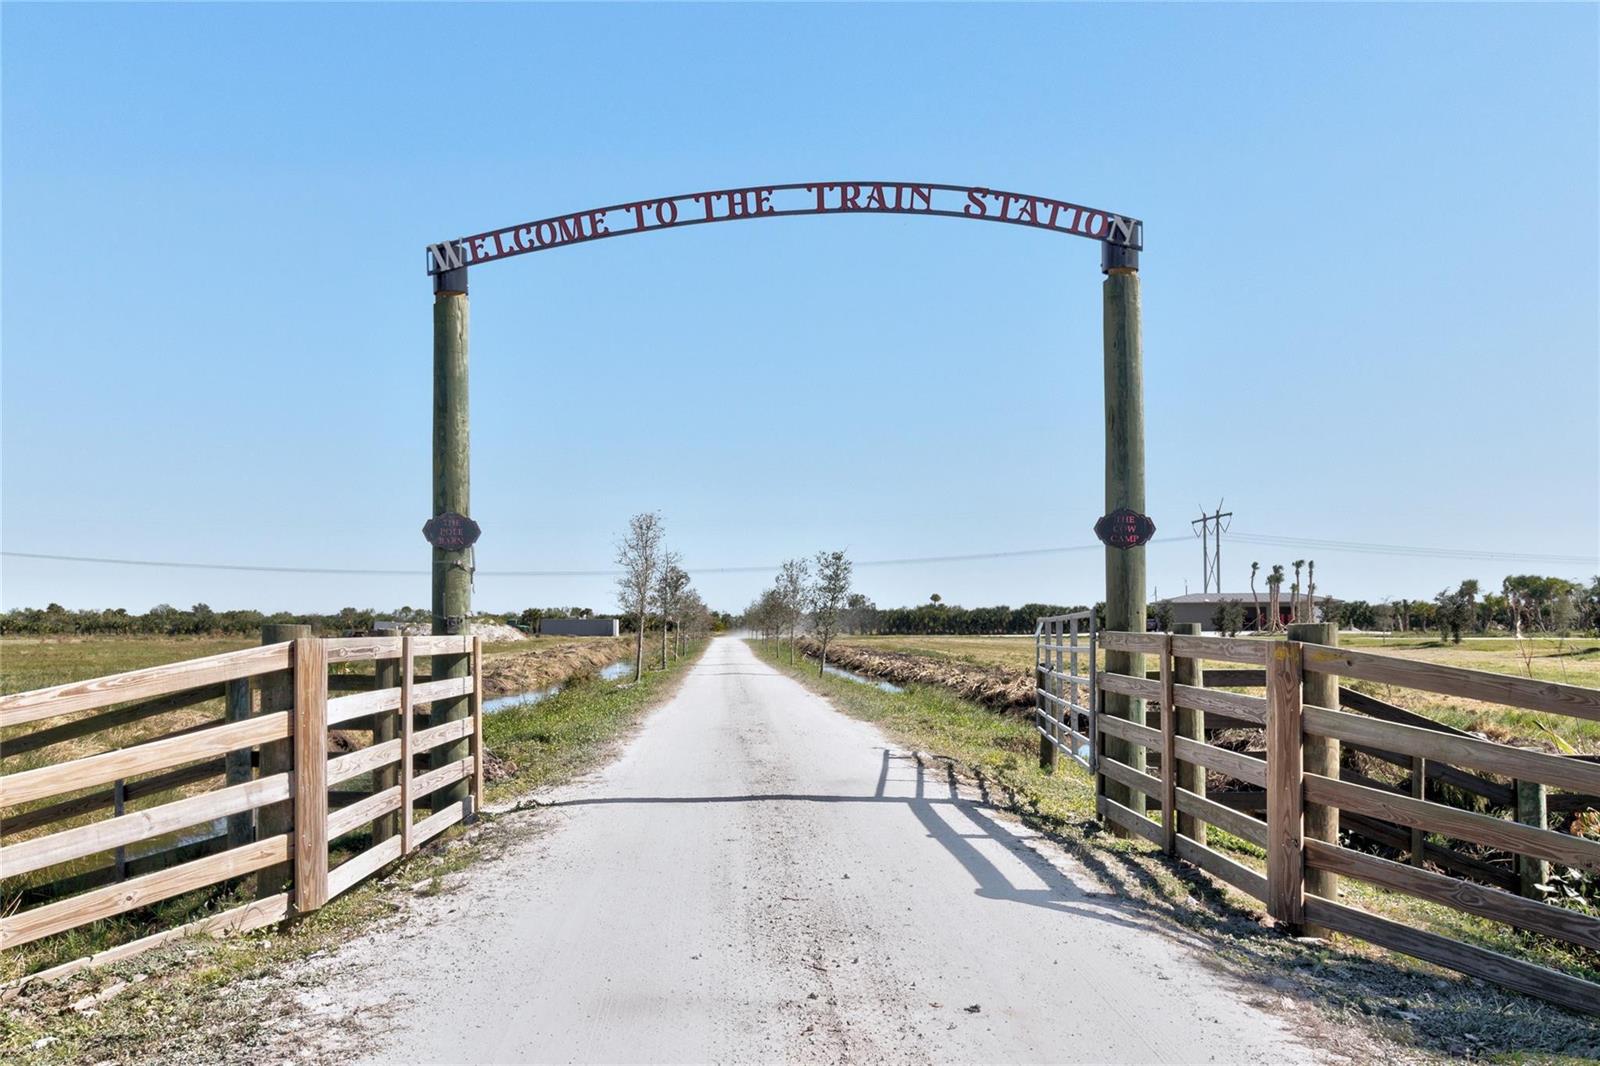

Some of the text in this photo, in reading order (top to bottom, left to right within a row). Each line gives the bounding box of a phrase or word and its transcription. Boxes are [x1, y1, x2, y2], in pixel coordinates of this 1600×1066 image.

[428, 183, 1136, 272] WELCOME TO THE TRAIN STATION
[1114, 515, 1135, 524] THE
